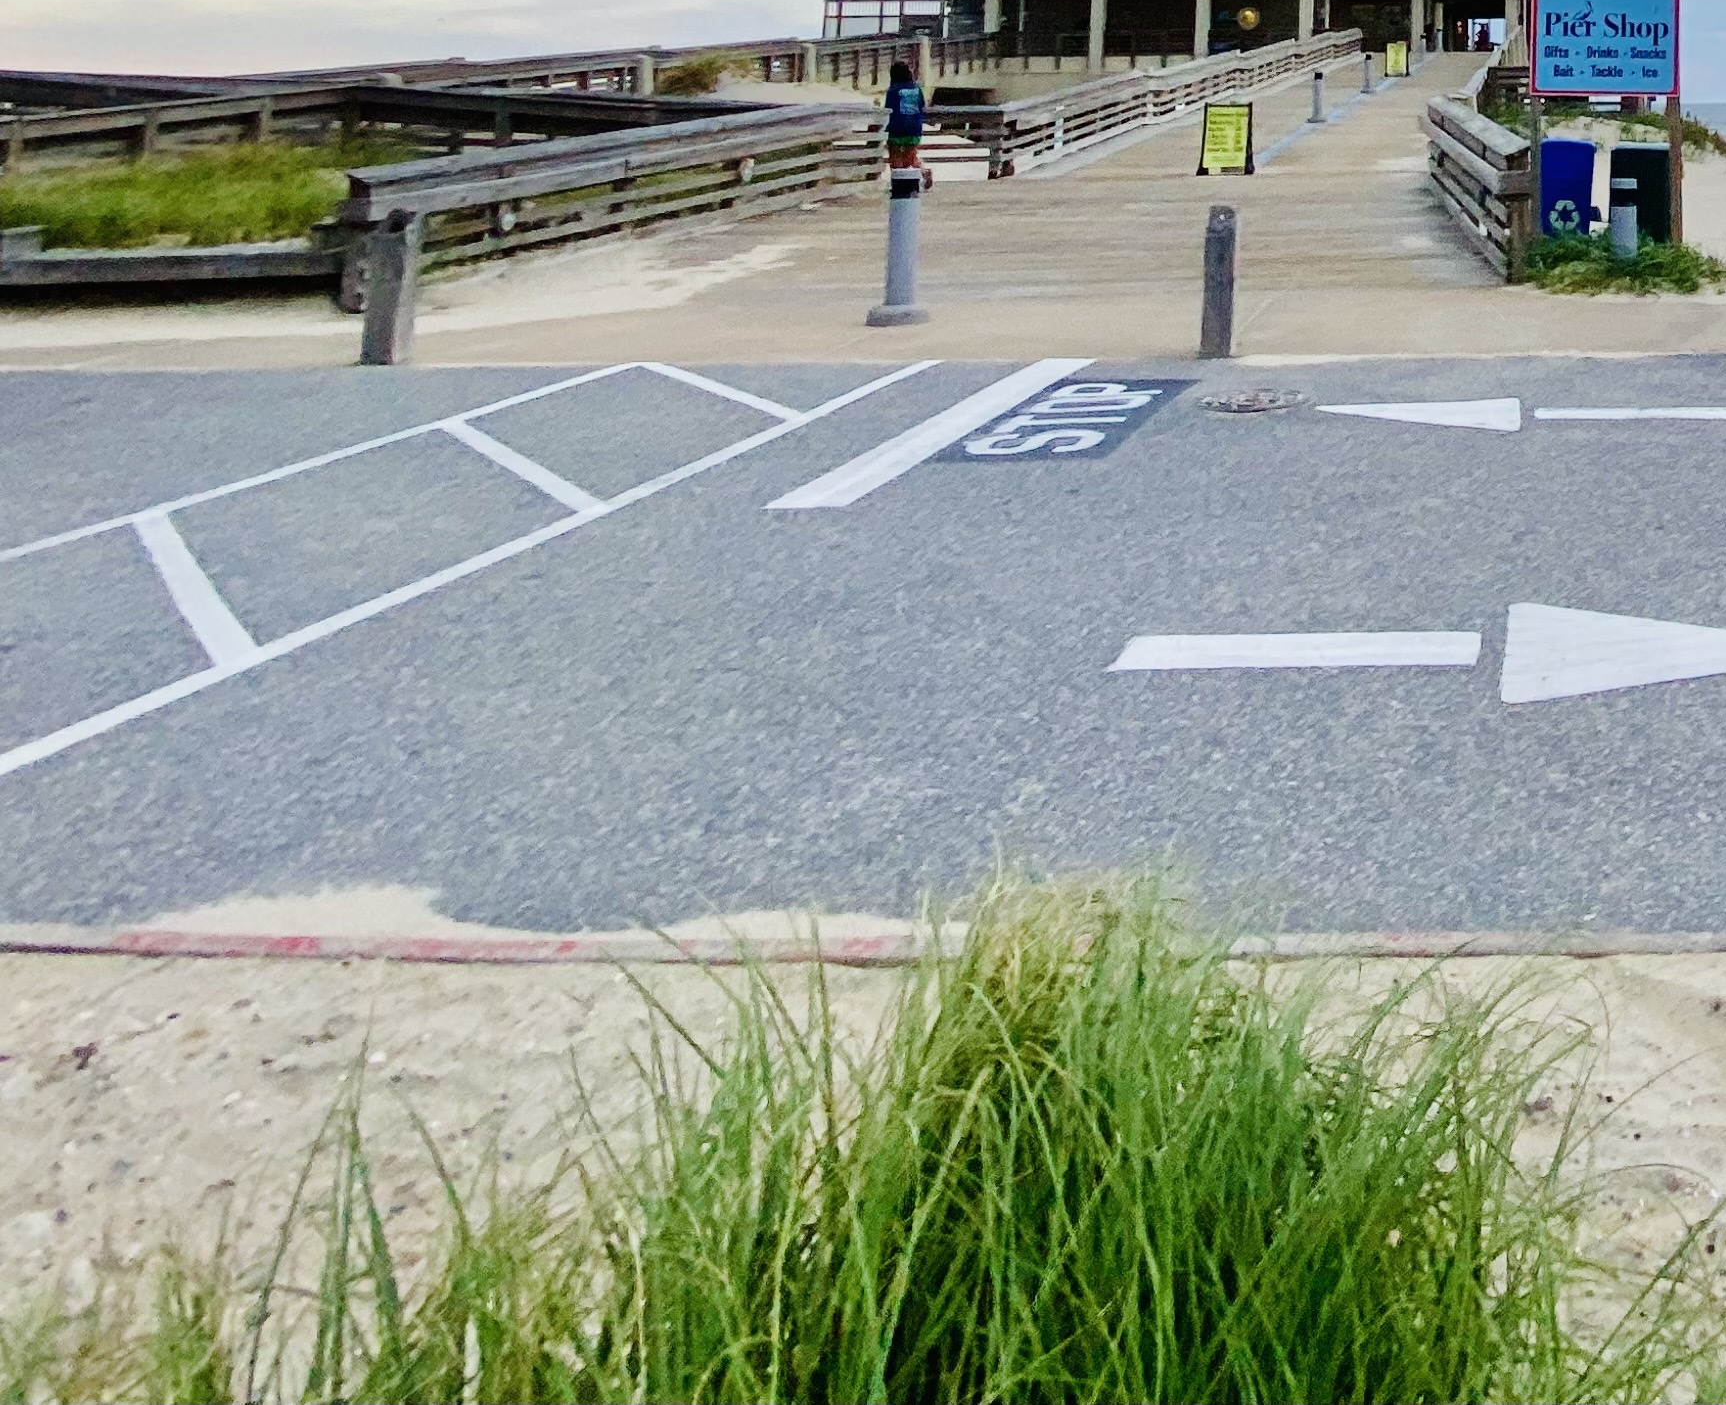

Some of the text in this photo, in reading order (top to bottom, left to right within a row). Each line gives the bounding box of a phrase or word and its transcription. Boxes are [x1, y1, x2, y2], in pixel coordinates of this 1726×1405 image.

[1544, 11, 1670, 46] Pier Shop
[1544, 45, 1667, 60] Gifts Drinks Snacks
[1553, 64, 1659, 78] Bait Tackle Ice
[964, 382, 1164, 456] STOP
